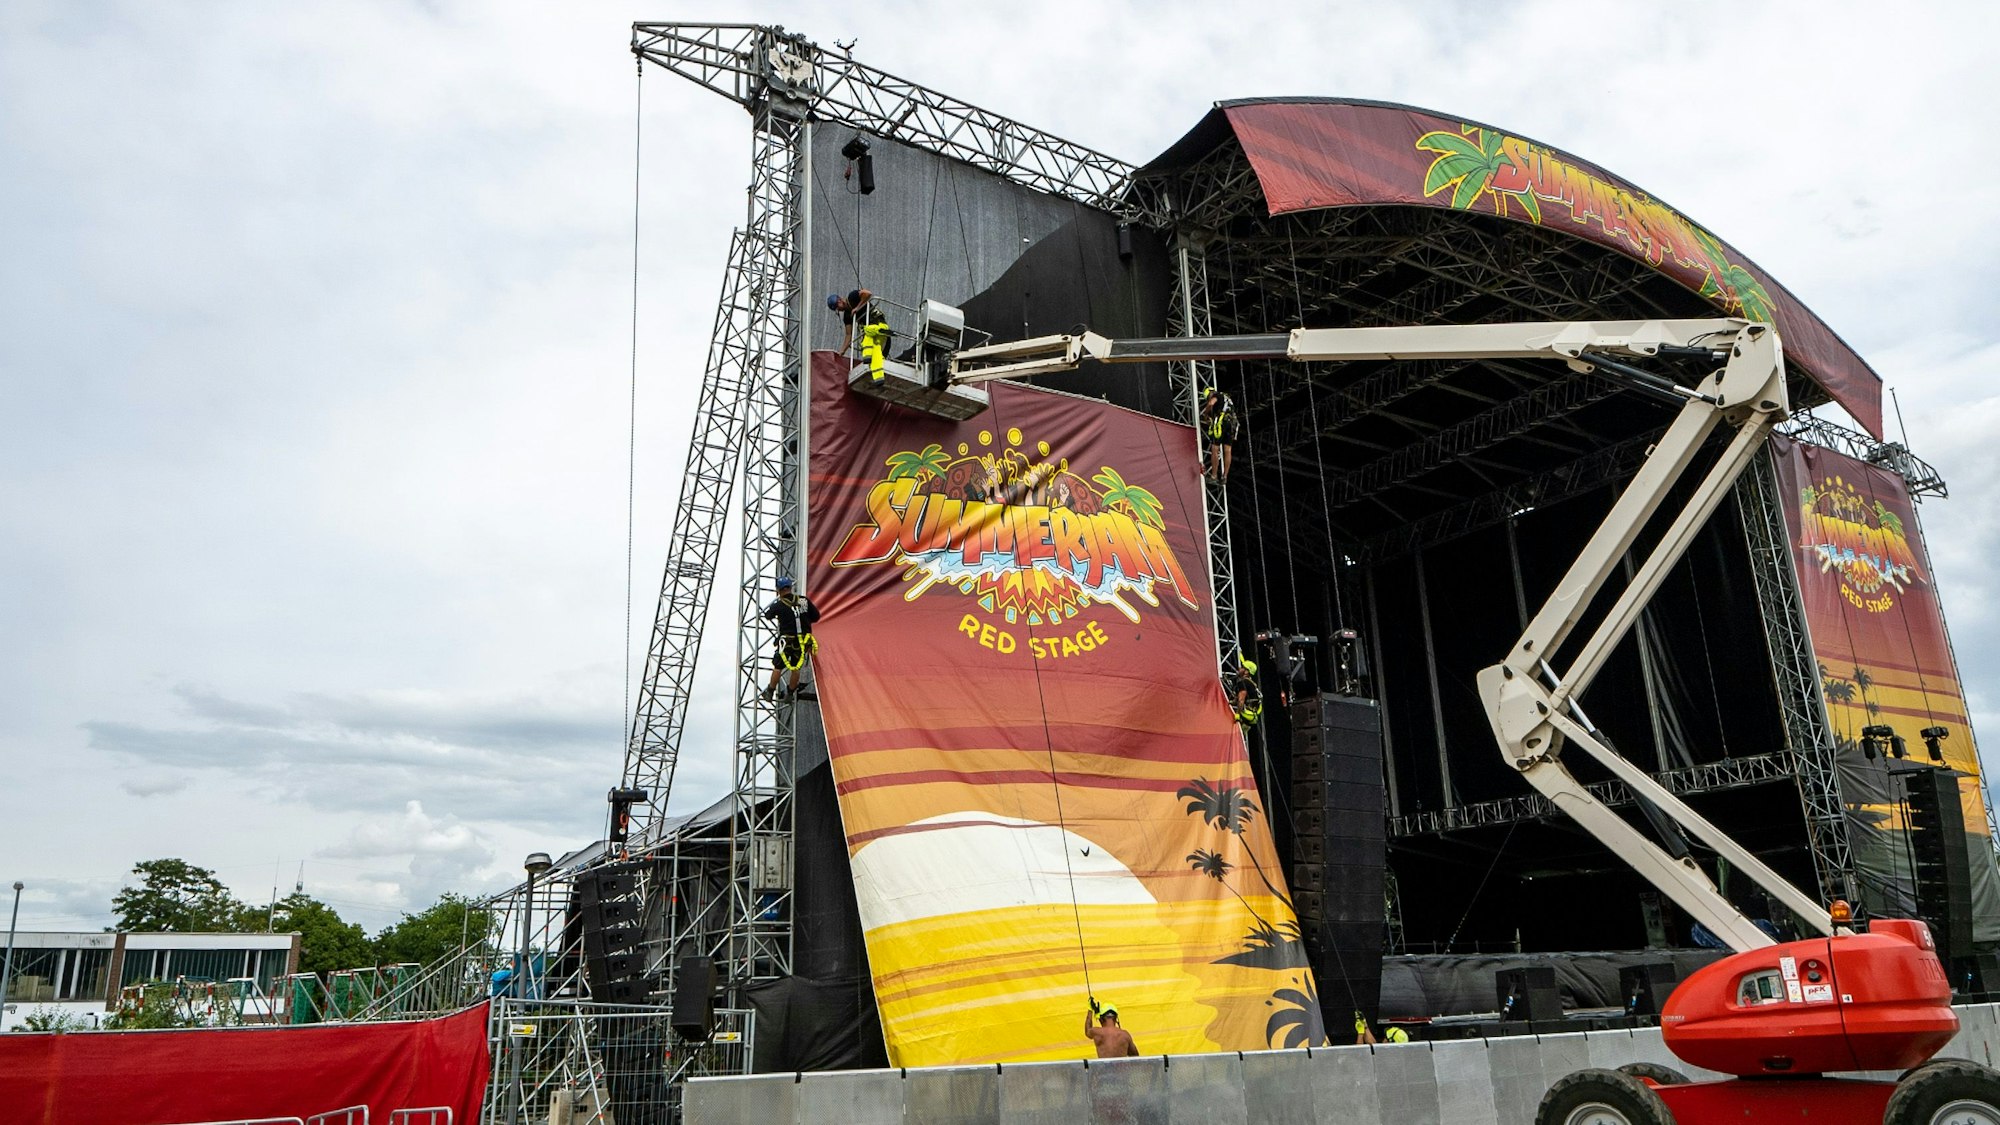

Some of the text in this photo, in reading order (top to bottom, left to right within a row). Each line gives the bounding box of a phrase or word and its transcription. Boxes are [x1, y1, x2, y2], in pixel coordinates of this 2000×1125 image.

[830, 476, 1199, 611] SUMMERJAM
[1841, 583, 1893, 613] RED STAGE
[958, 614, 1109, 660] RED STAGE
